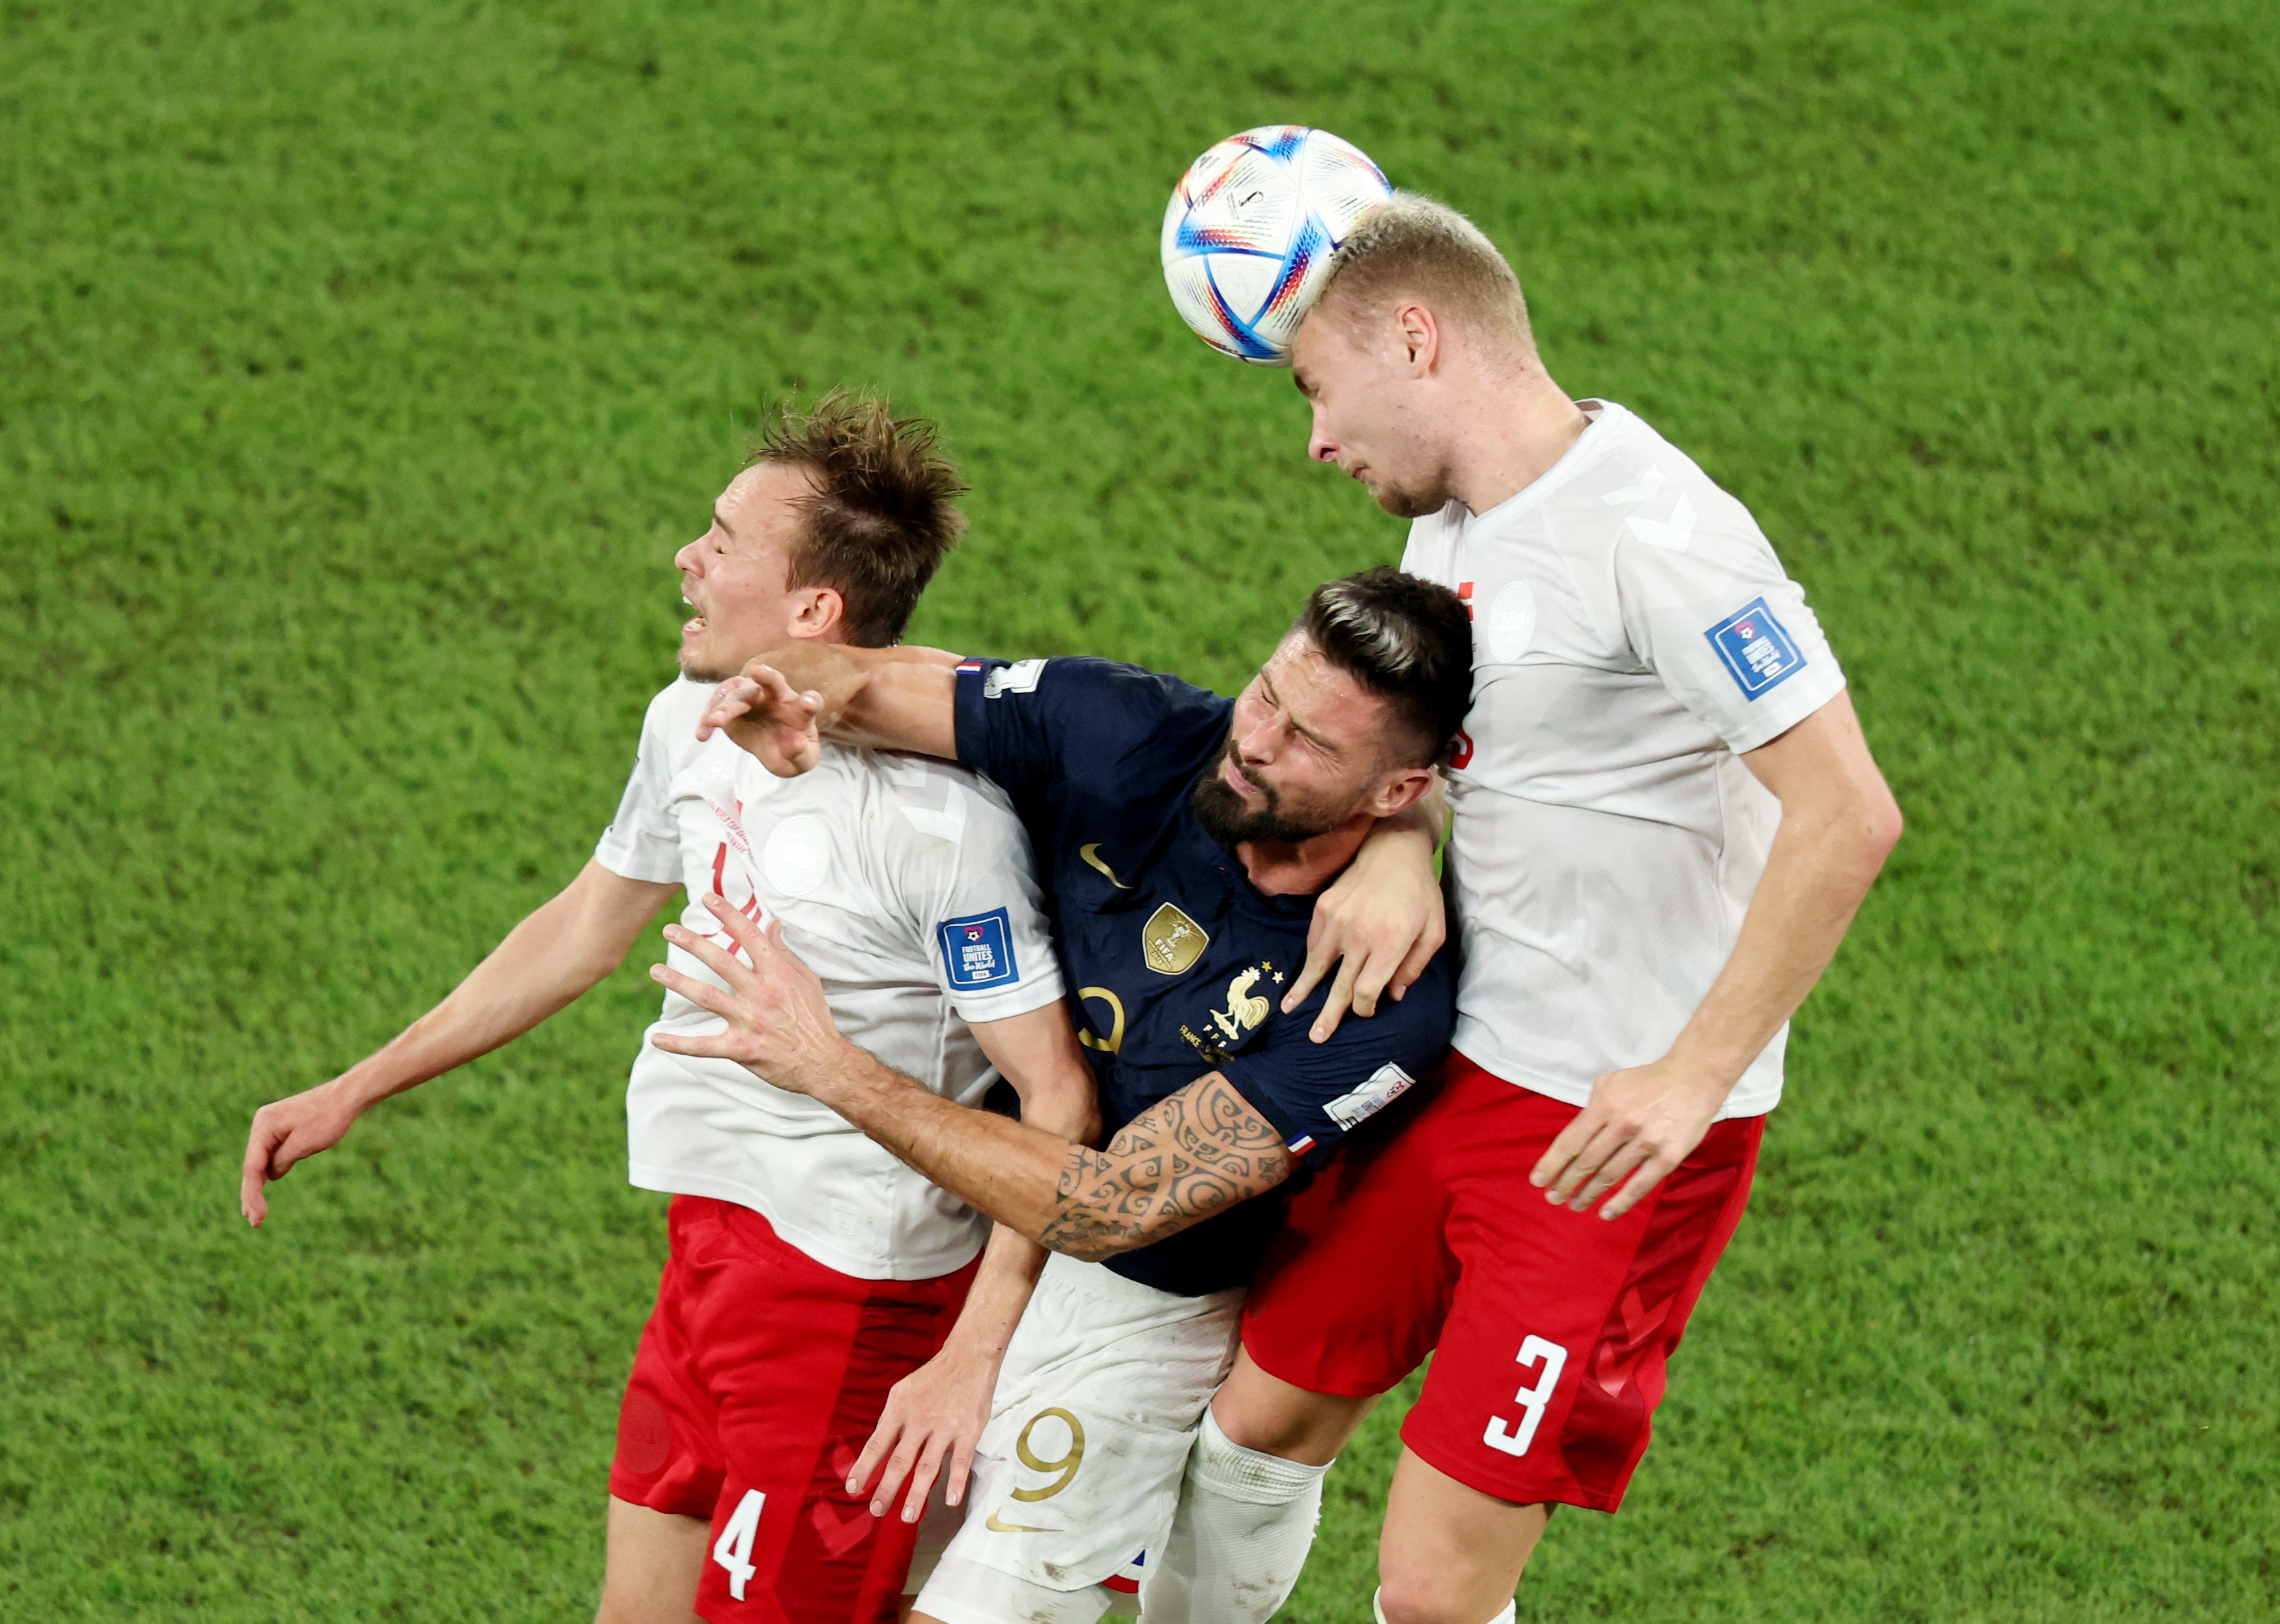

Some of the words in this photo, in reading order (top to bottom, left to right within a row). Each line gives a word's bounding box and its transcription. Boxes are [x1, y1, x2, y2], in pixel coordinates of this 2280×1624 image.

[962, 944, 991, 953] FOOTBALL
[963, 950, 993, 963] UNITES
[1154, 939, 1173, 962] FIFA
[1179, 1025, 1202, 1047] FRANCE
[1483, 1334, 1568, 1457] 3
[1010, 1407, 1085, 1502] 9
[713, 1489, 767, 1602] 4
